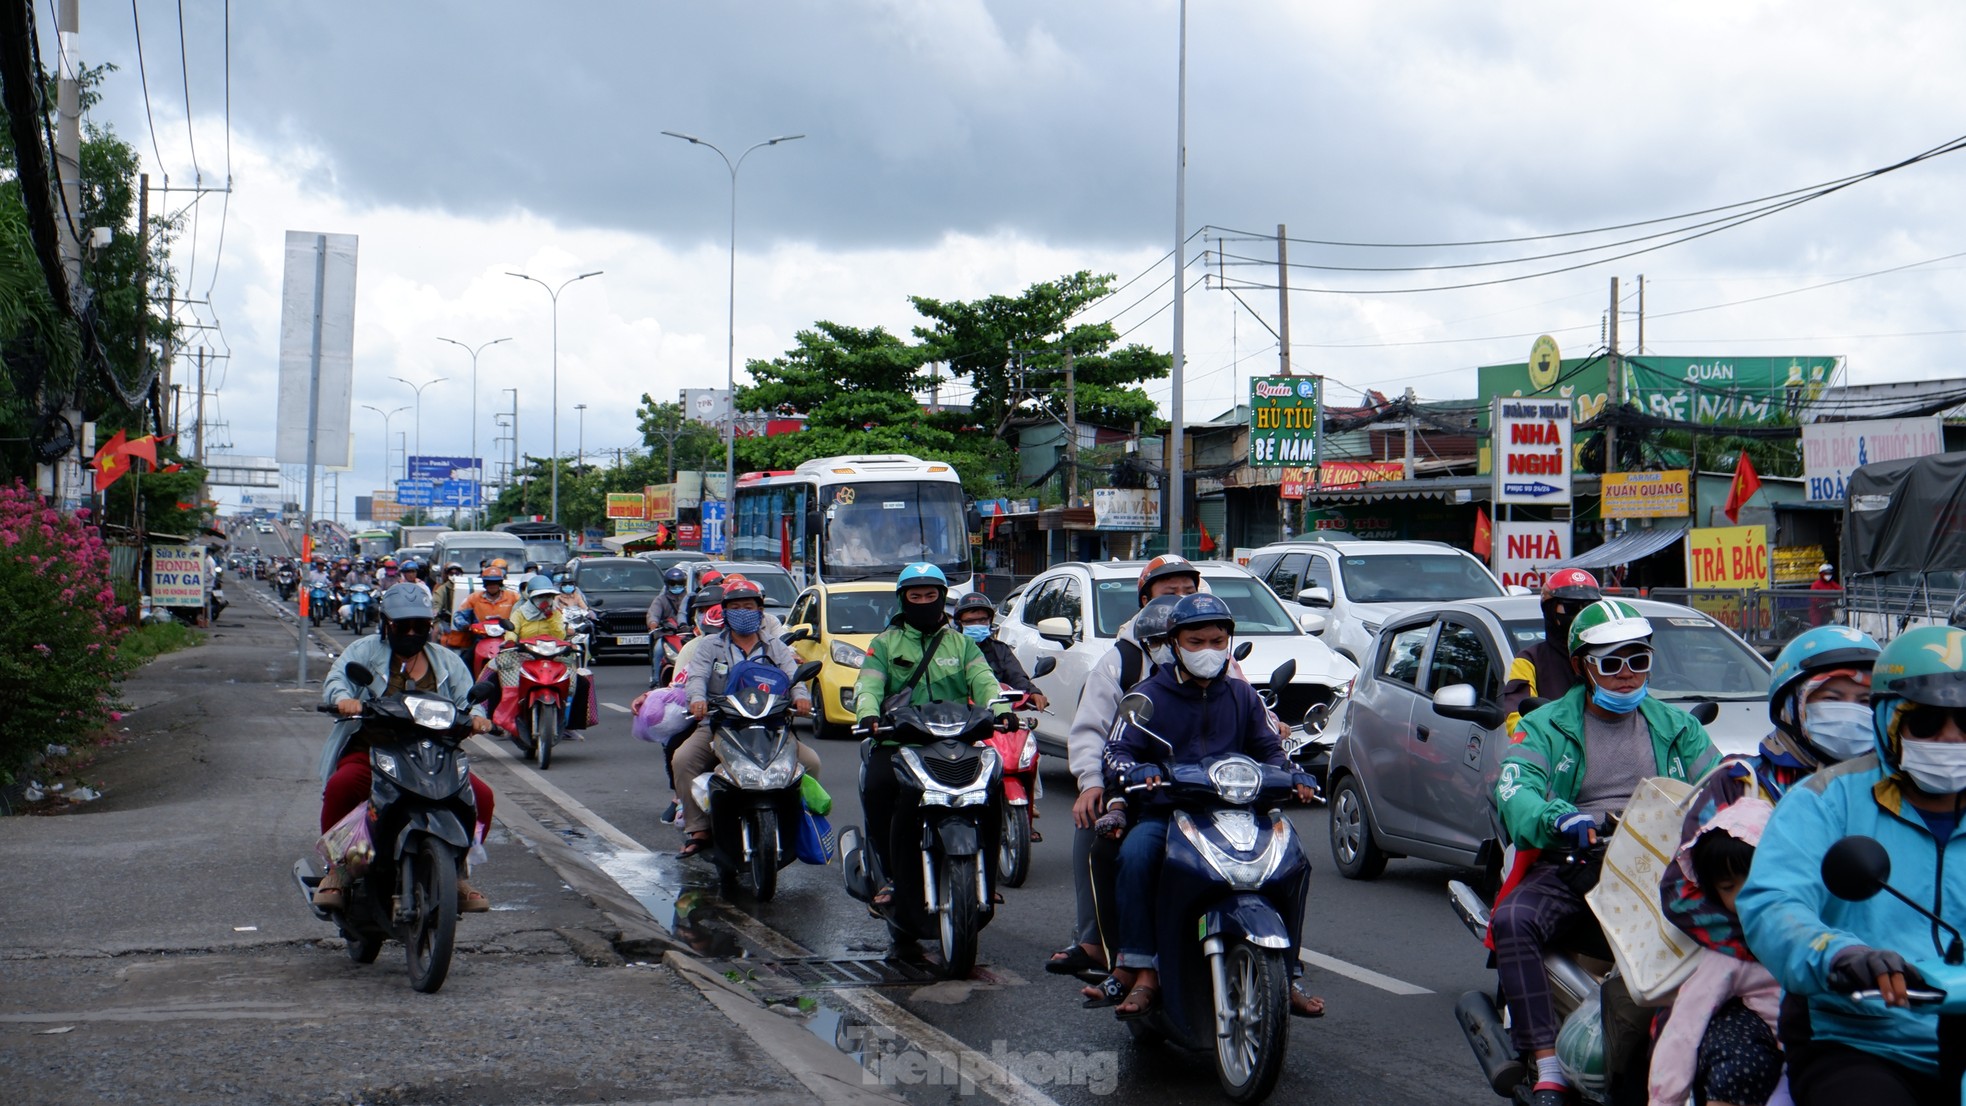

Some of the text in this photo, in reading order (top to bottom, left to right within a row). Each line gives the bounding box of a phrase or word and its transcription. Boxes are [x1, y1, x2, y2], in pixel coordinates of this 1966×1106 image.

[1688, 361, 1733, 381] QUÁN
[1256, 381, 1293, 399] Quán
[1257, 398, 1313, 429] HỦ TÍU
[1511, 420, 1561, 445] NHÀ
[1255, 431, 1314, 461] BÉ NĂM
[1807, 431, 1828, 468] TRÀ
[1858, 435, 1868, 465] &
[1507, 448, 1563, 475] NGHỈ
[1334, 469, 1359, 485] KHO
[1628, 473, 1662, 482] GARAGE
[1640, 482, 1684, 497] QUANG
[1507, 529, 1562, 560] NHÀ
[155, 561, 201, 571] HONDA
[1692, 529, 1768, 583] TRÀ BẮC
[155, 573, 201, 585] TAY GA
